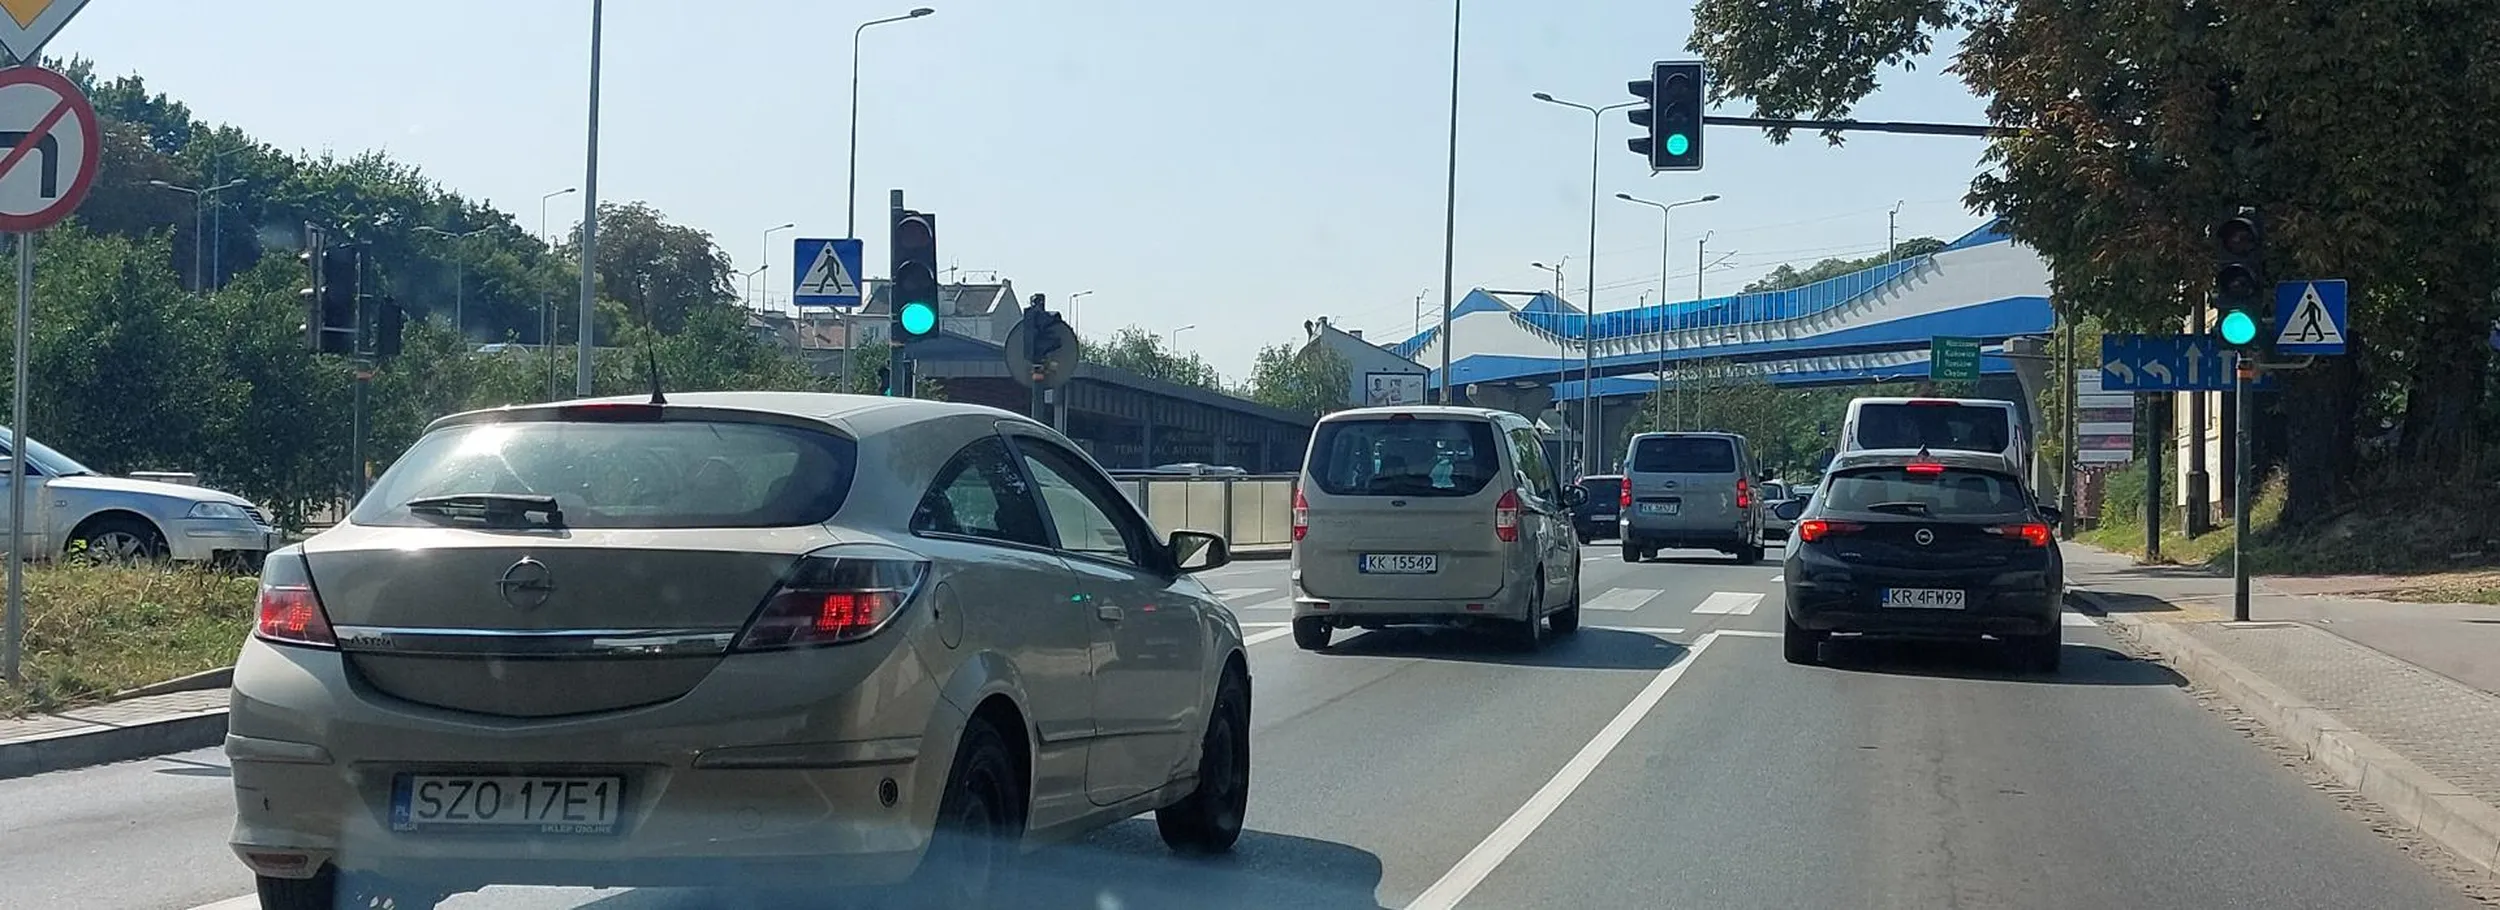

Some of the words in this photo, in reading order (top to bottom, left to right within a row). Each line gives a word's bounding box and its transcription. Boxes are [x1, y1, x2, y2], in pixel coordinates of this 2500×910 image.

[1114, 444, 1167, 456] TERMAL
[1369, 556, 1386, 569] KK
[1392, 556, 1433, 569] 15549
[1891, 589, 1913, 604] KR
[1917, 590, 1963, 605] 4FW99
[418, 781, 501, 820] SZO
[520, 781, 608, 821] 17E1
